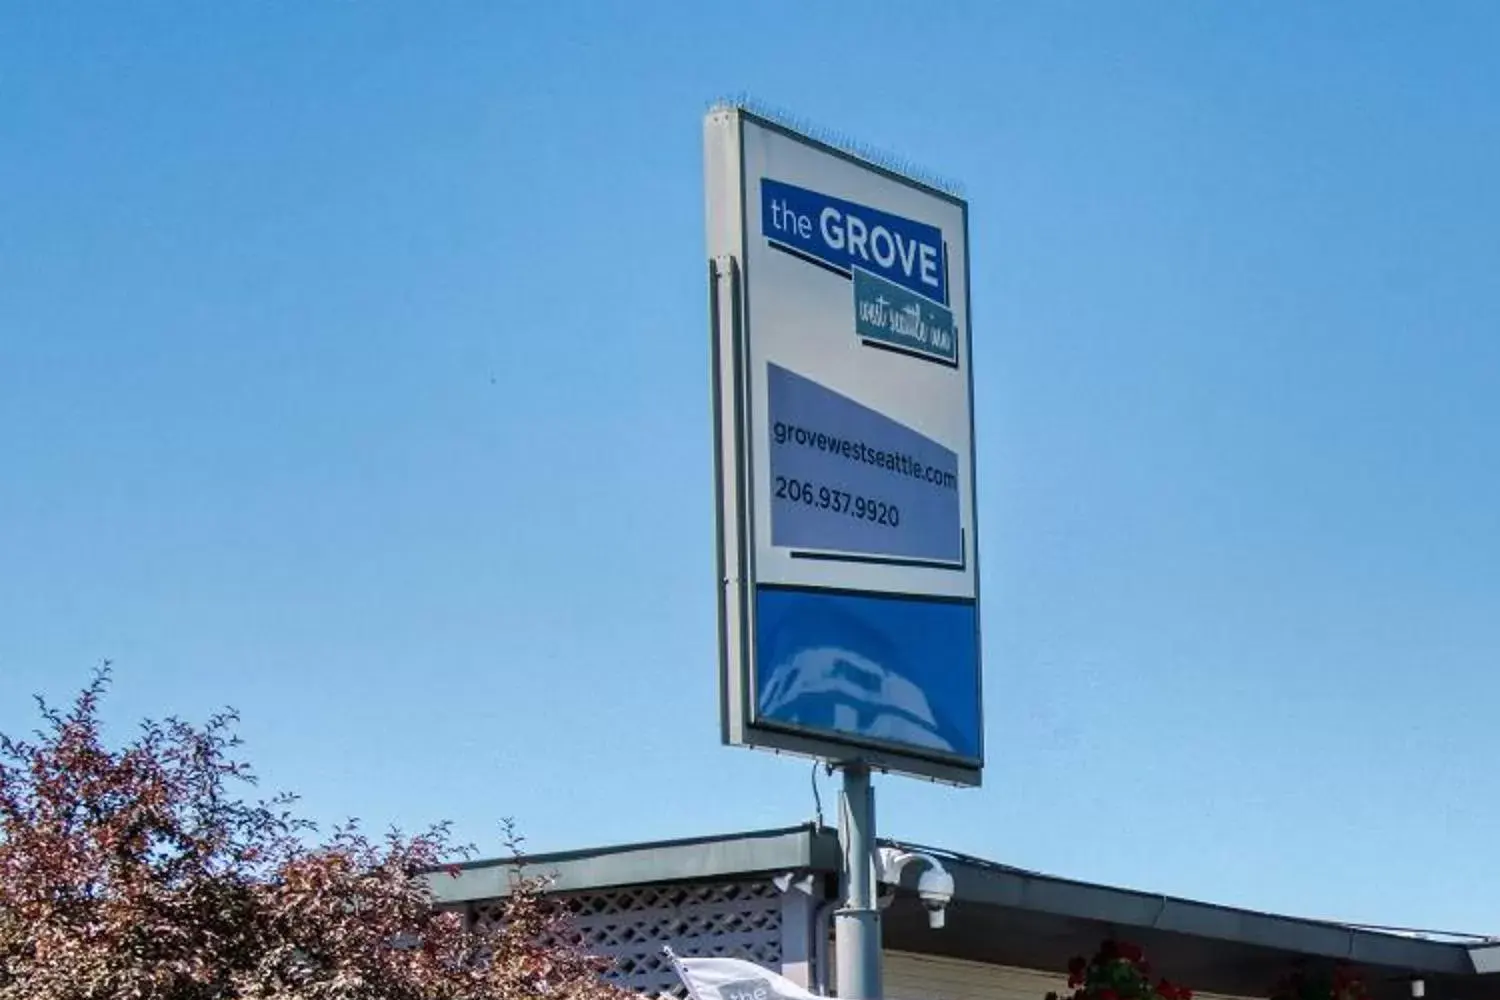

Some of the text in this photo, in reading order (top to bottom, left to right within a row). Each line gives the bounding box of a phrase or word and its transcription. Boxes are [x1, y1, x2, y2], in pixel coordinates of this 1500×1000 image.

[771, 198, 939, 288] the GROVE
[773, 420, 958, 491] grovewestseattle.com
[775, 475, 900, 527] 206.937.9920
